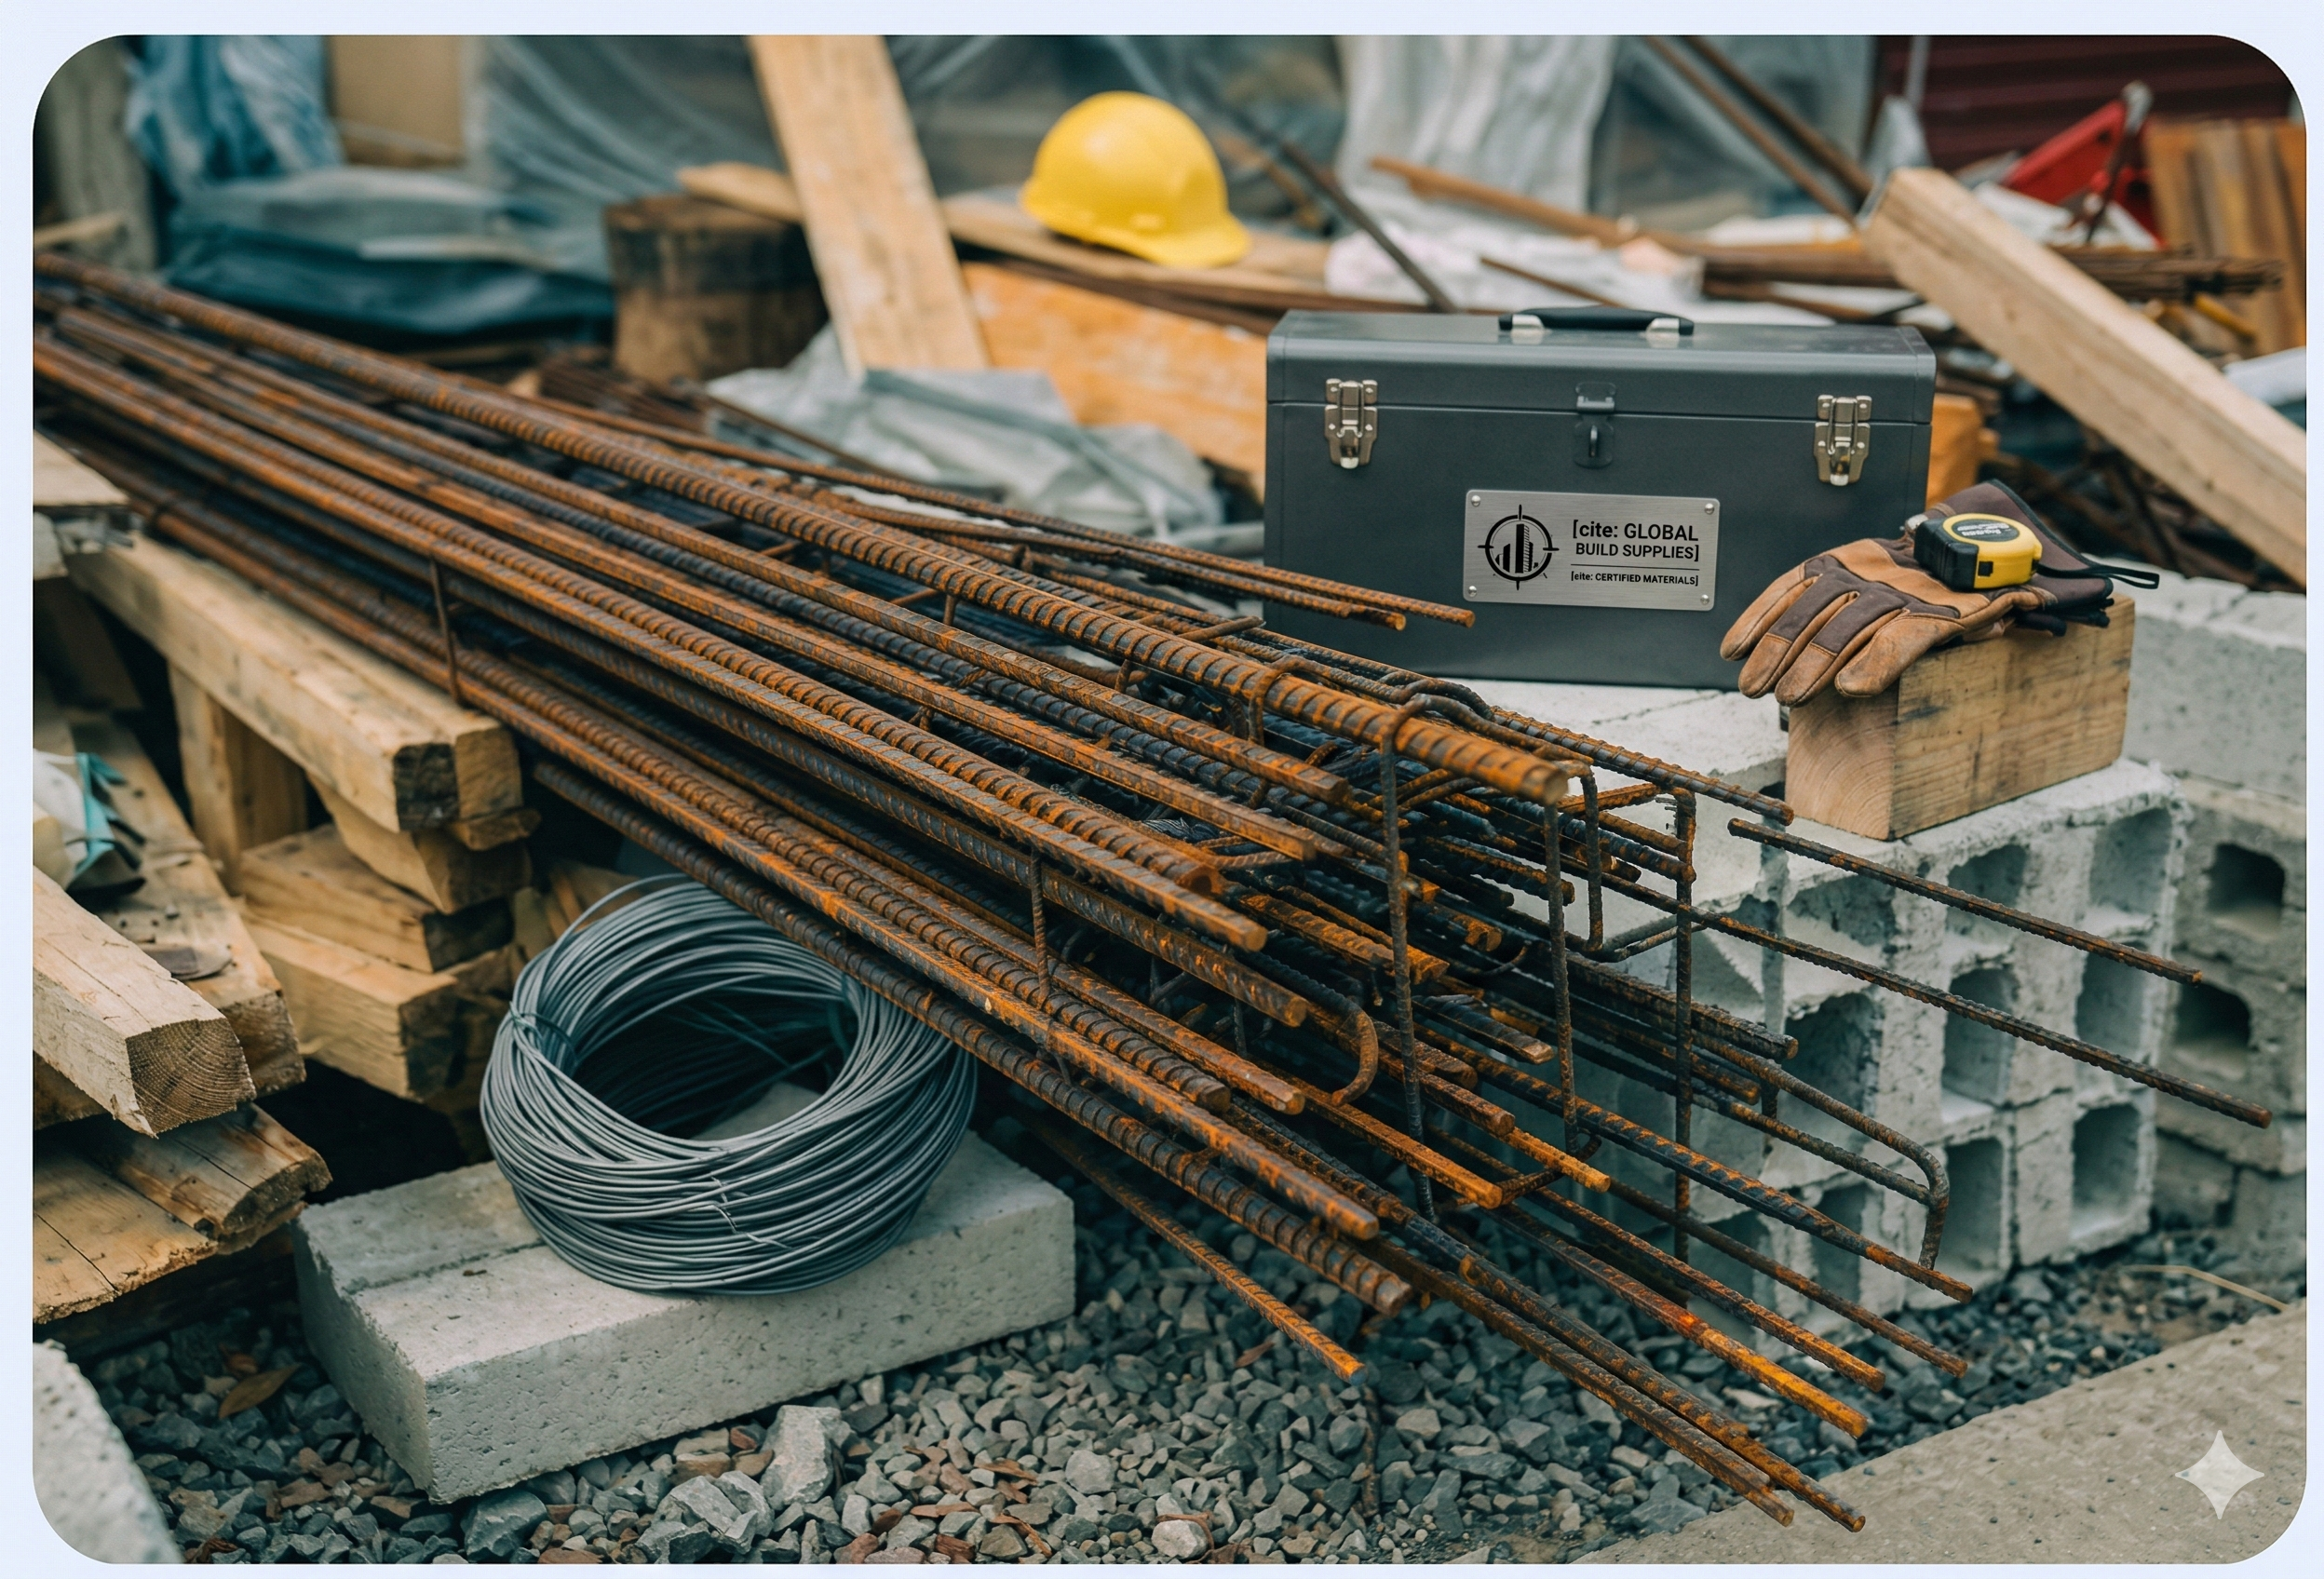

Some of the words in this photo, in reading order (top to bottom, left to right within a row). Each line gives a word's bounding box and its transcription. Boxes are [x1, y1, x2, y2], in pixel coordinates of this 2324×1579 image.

[1573, 520, 1618, 538] [cite:
[1624, 522, 1699, 541] GLOBAL
[1575, 542, 1618, 556] BUILD
[1622, 544, 1699, 562] SUPPLIES]
[1595, 573, 1641, 583] CERTIFIED
[1642, 574, 1698, 587] MATERIALS]
